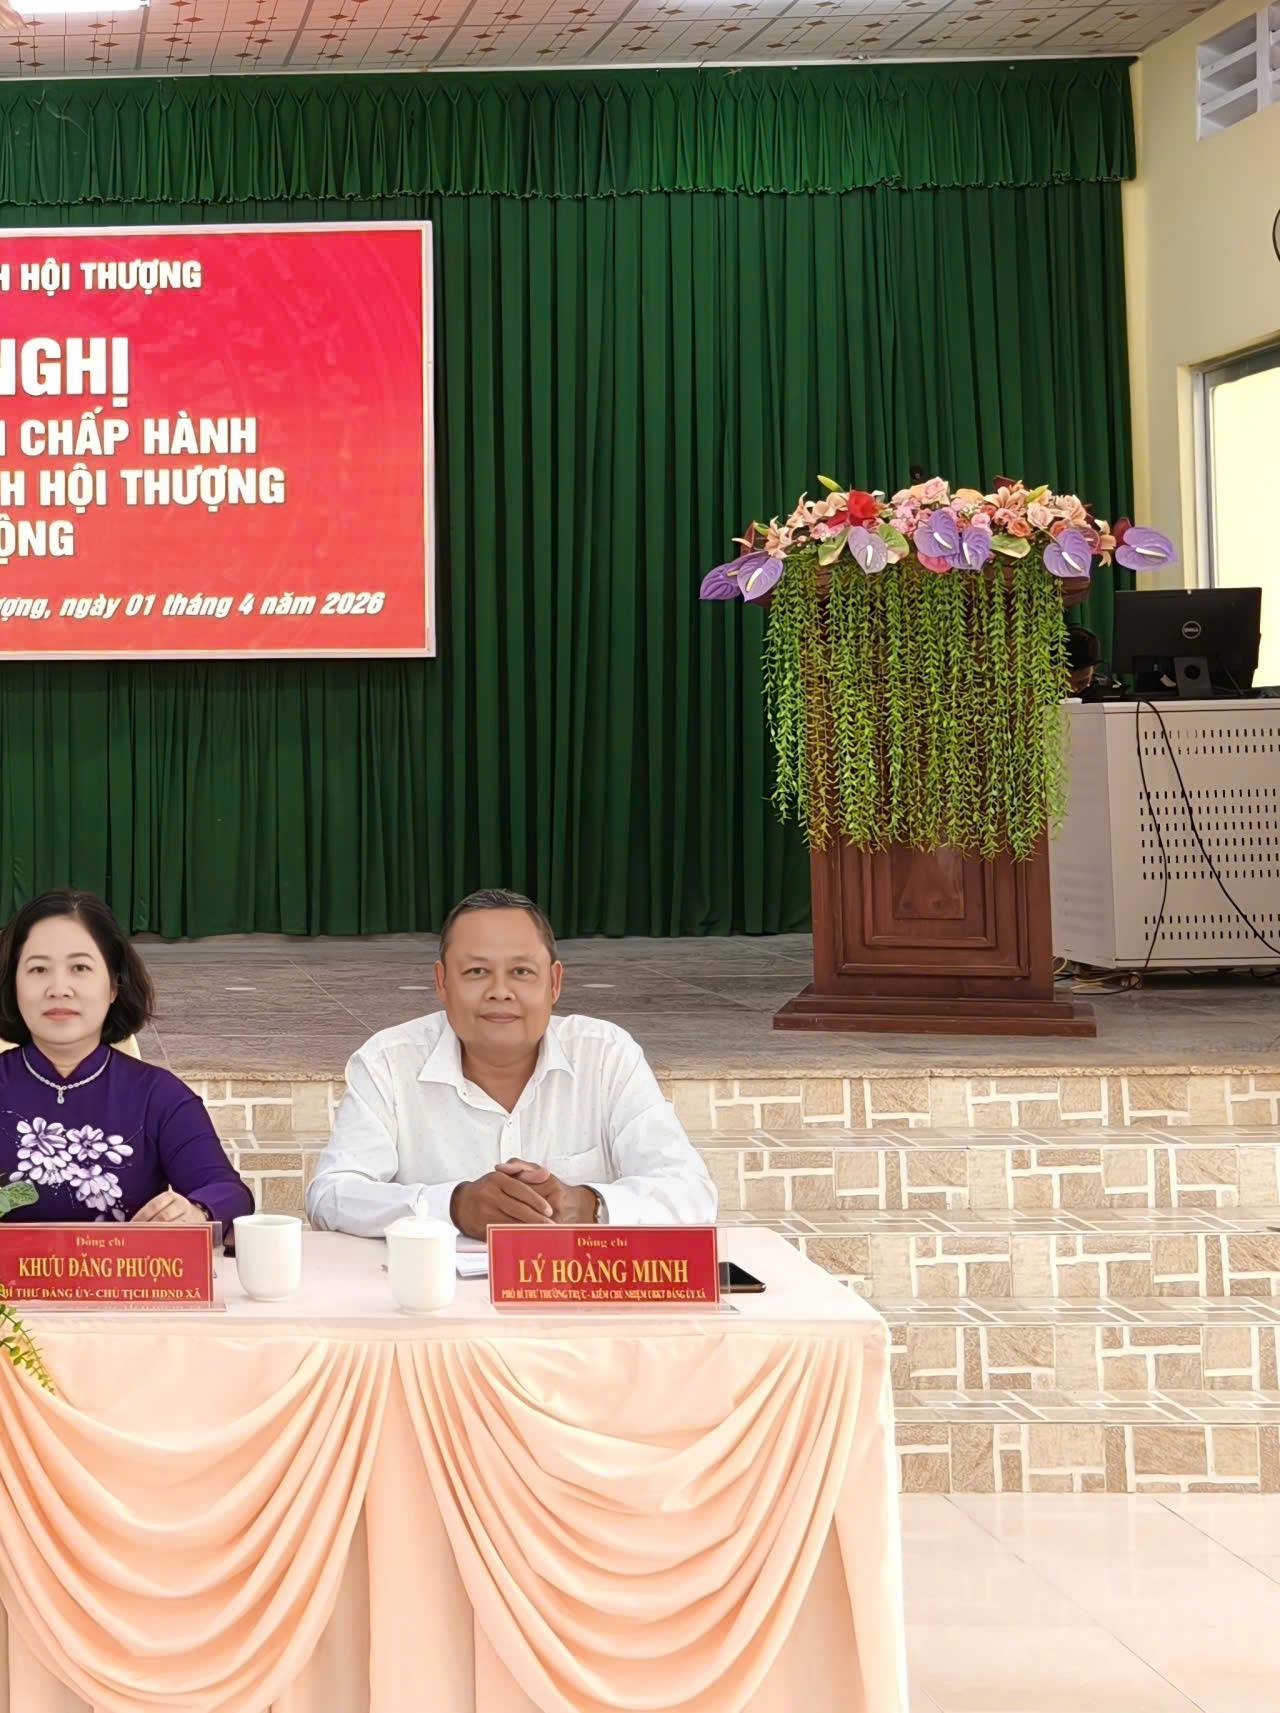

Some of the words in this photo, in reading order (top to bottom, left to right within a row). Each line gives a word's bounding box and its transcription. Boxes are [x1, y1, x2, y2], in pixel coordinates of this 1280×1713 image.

[20, 257, 71, 297] HỘI
[79, 258, 202, 295] THƯỢNG
[20, 406, 130, 457] CHẤP
[143, 410, 257, 455] HÀNH
[39, 462, 107, 514] HỘI
[119, 464, 285, 512] THƯỢNG
[59, 593, 121, 619] ngày
[125, 593, 156, 617] 01
[162, 592, 234, 619] tháng
[237, 592, 256, 616] 4
[259, 591, 317, 616] năm
[320, 591, 386, 616] 2026
[68, 1253, 113, 1278] ĐĂNG
[116, 1255, 184, 1283] PHƯỢNG
[518, 1253, 546, 1283] LÝ
[551, 1253, 627, 1283] HOÀNG
[631, 1259, 689, 1283] MINH
